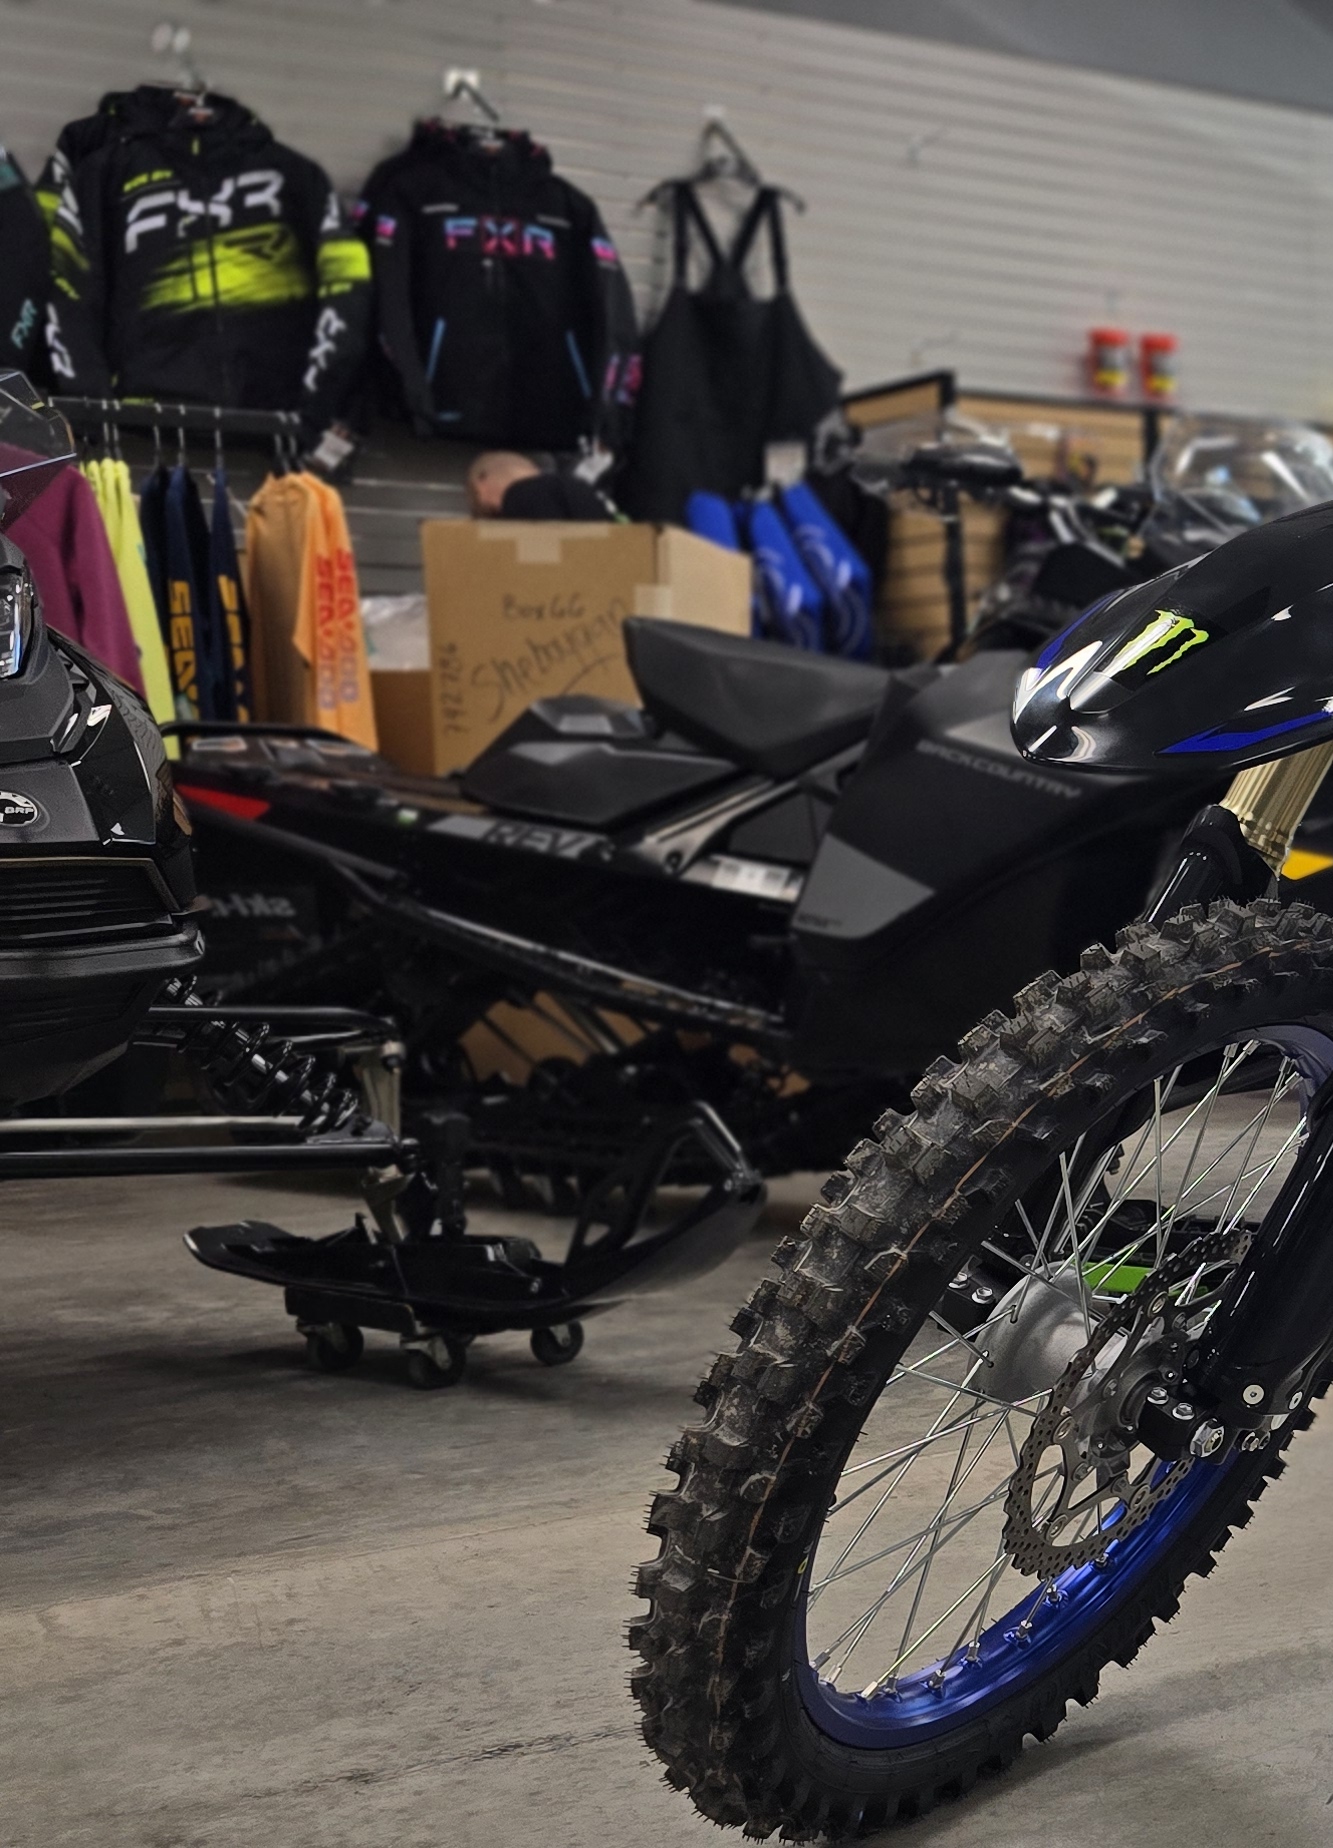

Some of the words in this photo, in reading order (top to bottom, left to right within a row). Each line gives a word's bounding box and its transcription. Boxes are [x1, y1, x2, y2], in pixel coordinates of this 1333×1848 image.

[125, 169, 284, 253] FXR
[444, 216, 556, 260] FXR
[915, 738, 1083, 798] BACKCOUNTRY
[4, 806, 34, 815] BRP
